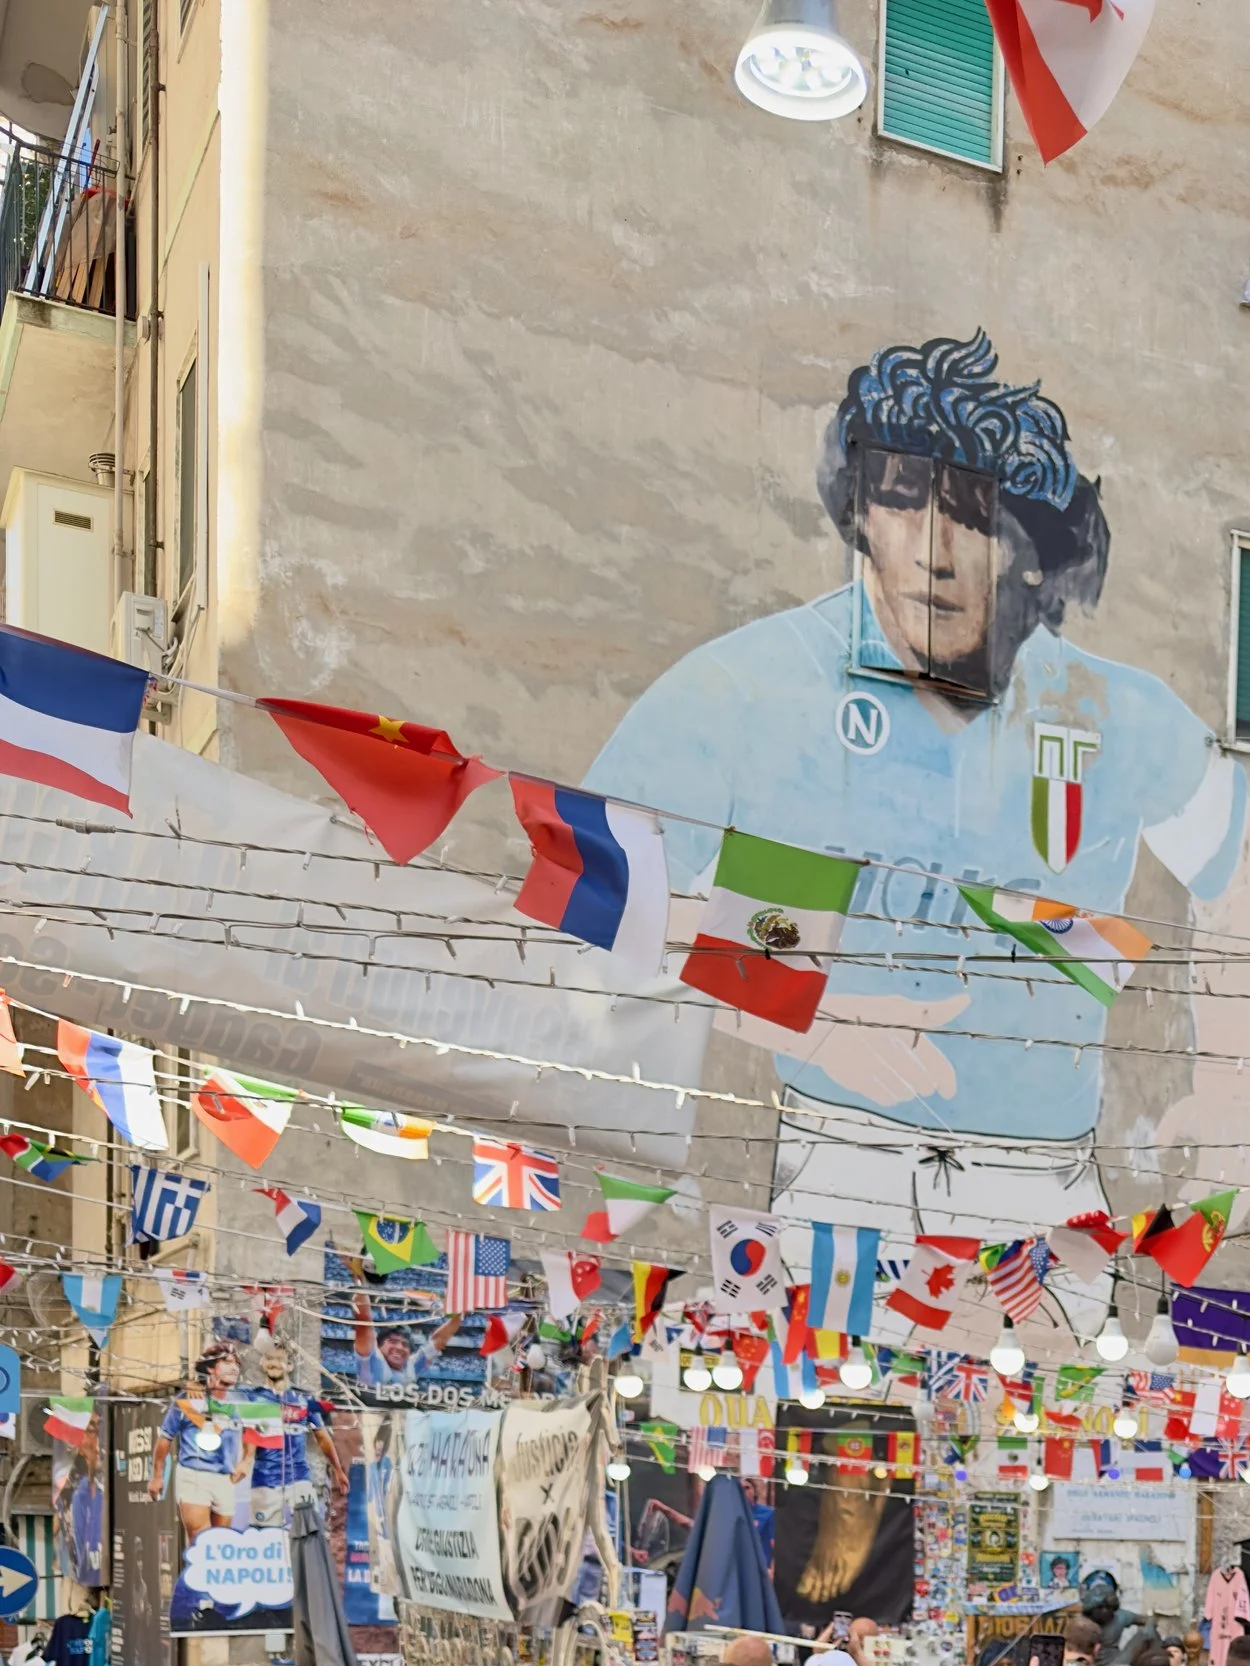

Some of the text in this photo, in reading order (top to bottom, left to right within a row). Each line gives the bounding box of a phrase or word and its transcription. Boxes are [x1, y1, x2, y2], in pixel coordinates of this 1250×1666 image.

[427, 1385, 472, 1407] DOS
[205, 1542, 282, 1561] L'Oro di
[206, 1566, 293, 1585] NAPOLI!
